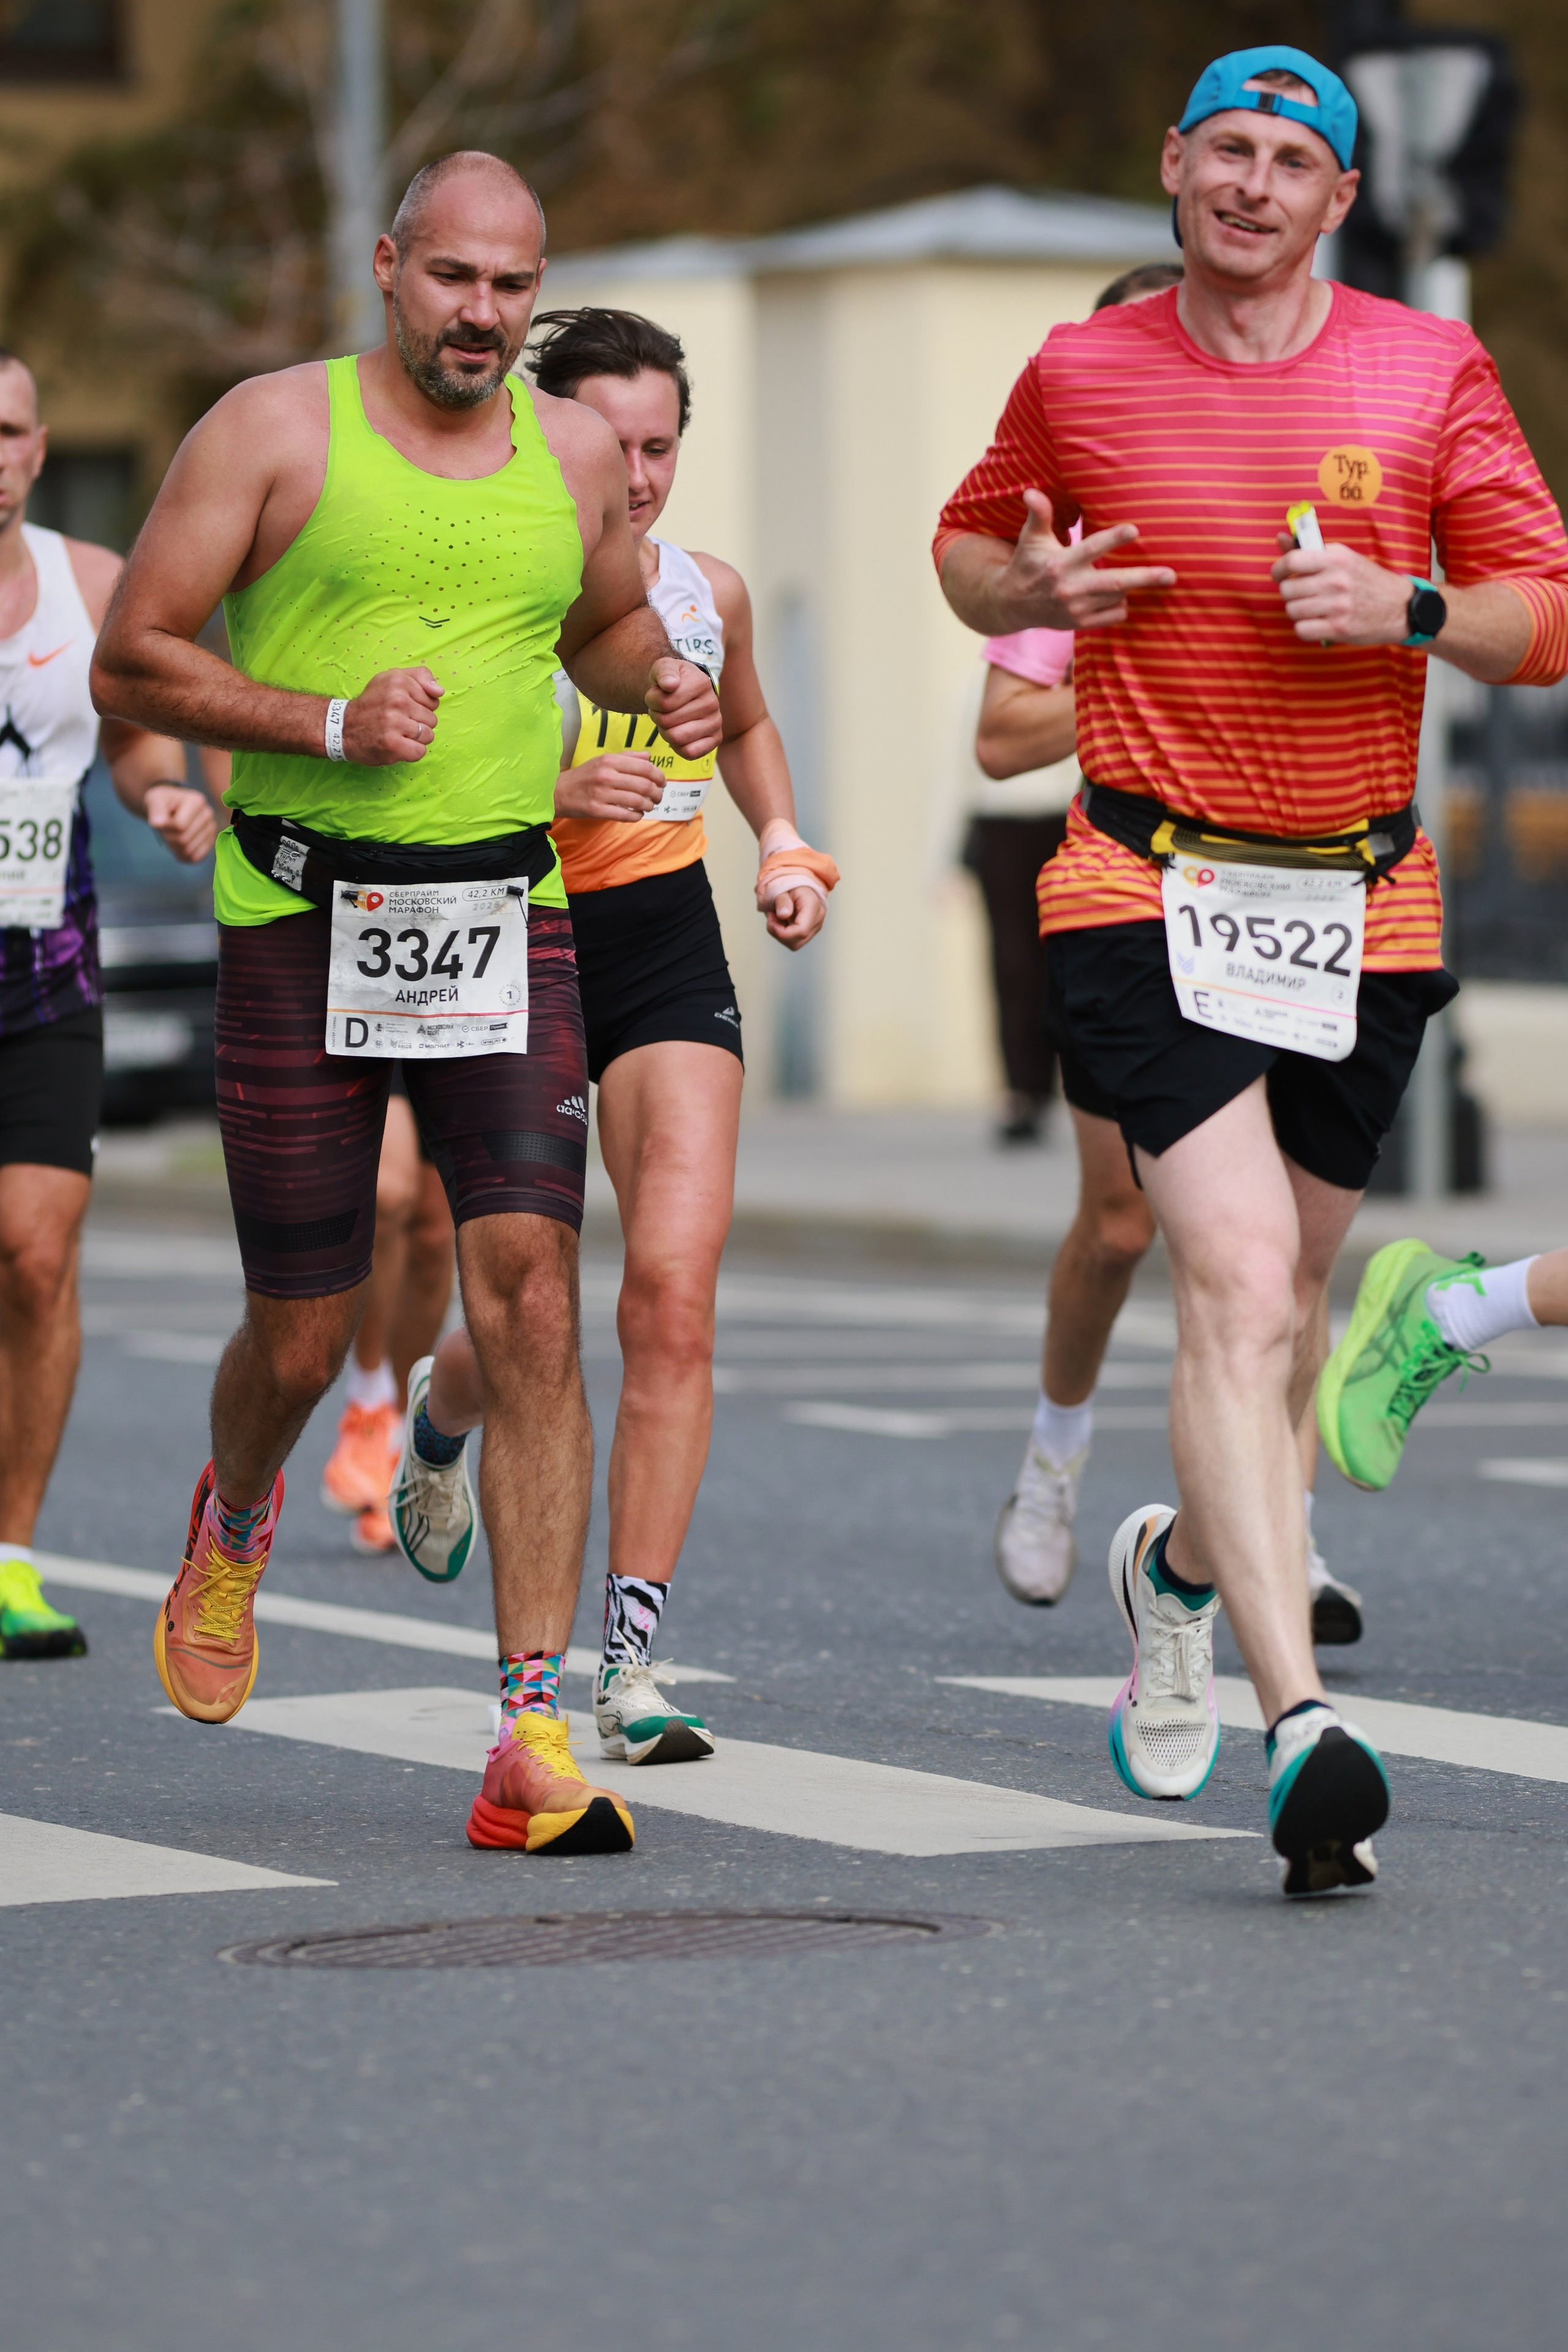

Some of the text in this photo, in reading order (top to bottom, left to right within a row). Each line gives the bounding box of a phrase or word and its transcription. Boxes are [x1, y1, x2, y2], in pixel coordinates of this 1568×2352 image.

[330, 701, 343, 725] 3347
[332, 733, 341, 753] 42,2
[388, 889, 440, 898] СБЕРПРАЙМ
[388, 895, 458, 906] МОСКОВСКИЙ
[467, 888, 505, 899] 42,2 КМ
[388, 906, 440, 914] МАРАФОН
[1178, 904, 1352, 978] 19522
[356, 925, 501, 982] 3347
[1226, 962, 1306, 990] ВЛАДИМИР
[394, 985, 459, 1006] АНДРЕЙ
[506, 990, 512, 999] 1
[1194, 990, 1213, 1020] E
[345, 1017, 369, 1048] D
